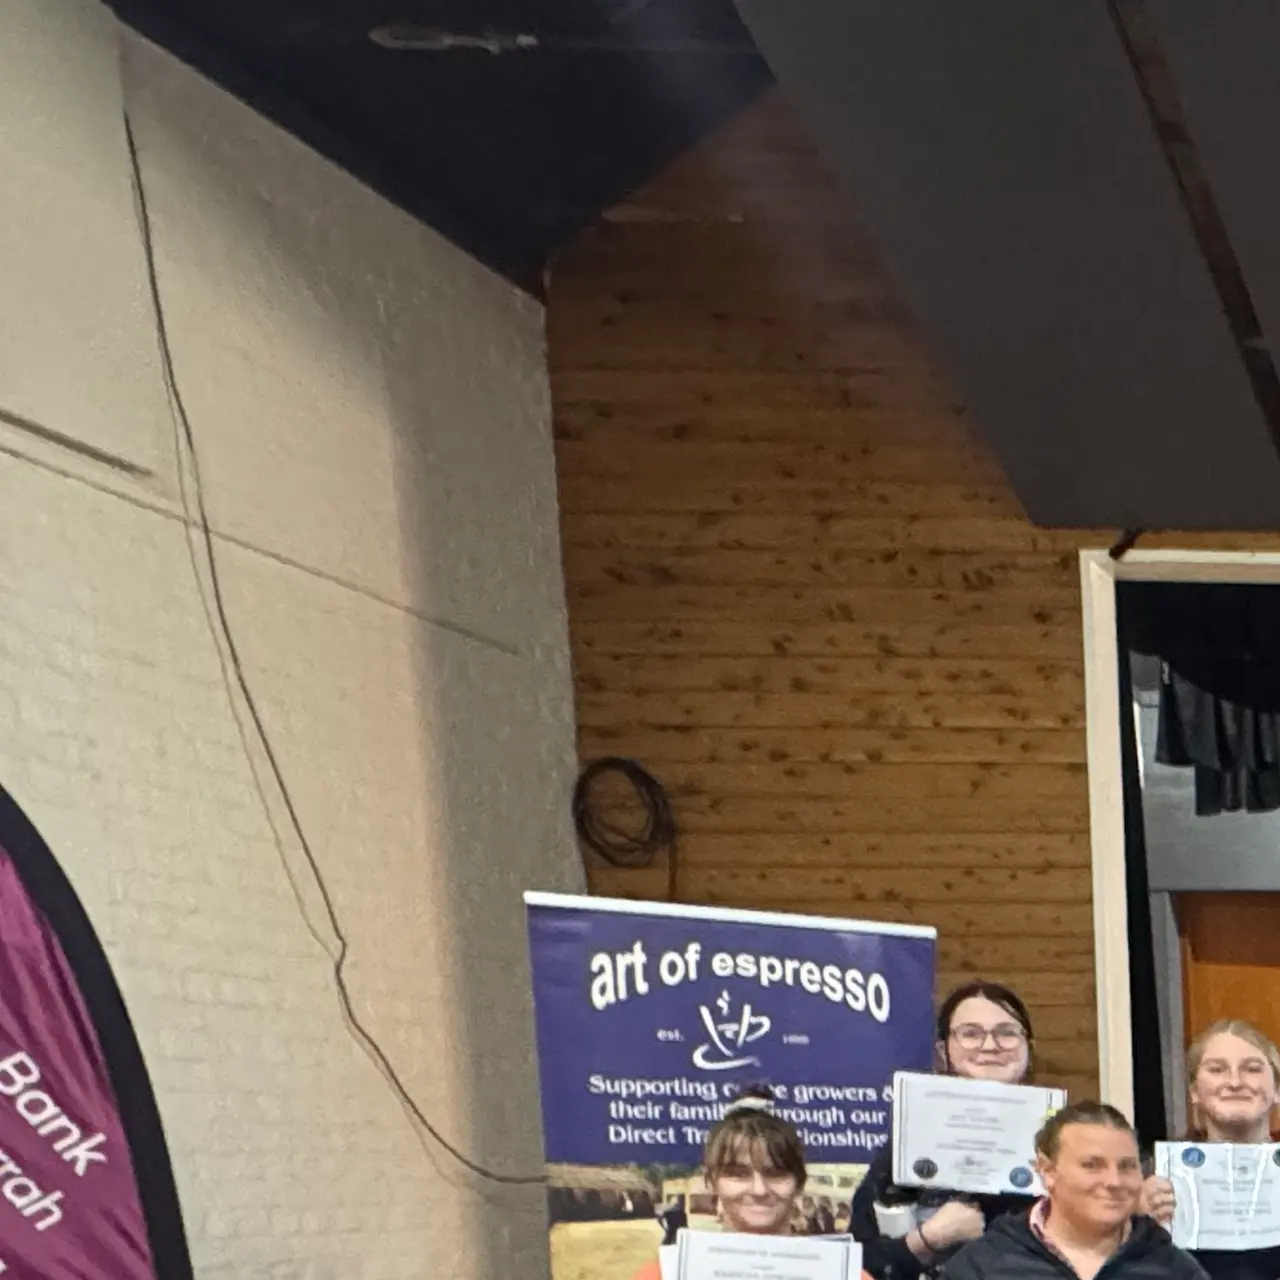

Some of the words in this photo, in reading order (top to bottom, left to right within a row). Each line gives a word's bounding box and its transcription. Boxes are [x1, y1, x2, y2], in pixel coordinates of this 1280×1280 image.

[590, 940, 648, 1010] art
[659, 942, 700, 985] of
[712, 951, 890, 1023] espresso
[588, 1074, 718, 1101] Supporting
[793, 1083, 878, 1104] growers
[0, 1051, 108, 1177] Bank
[609, 1100, 663, 1119] their
[670, 1101, 729, 1121] famil
[851, 1108, 888, 1125] our
[608, 1123, 676, 1144] Direct
[681, 1125, 711, 1146] Tra
